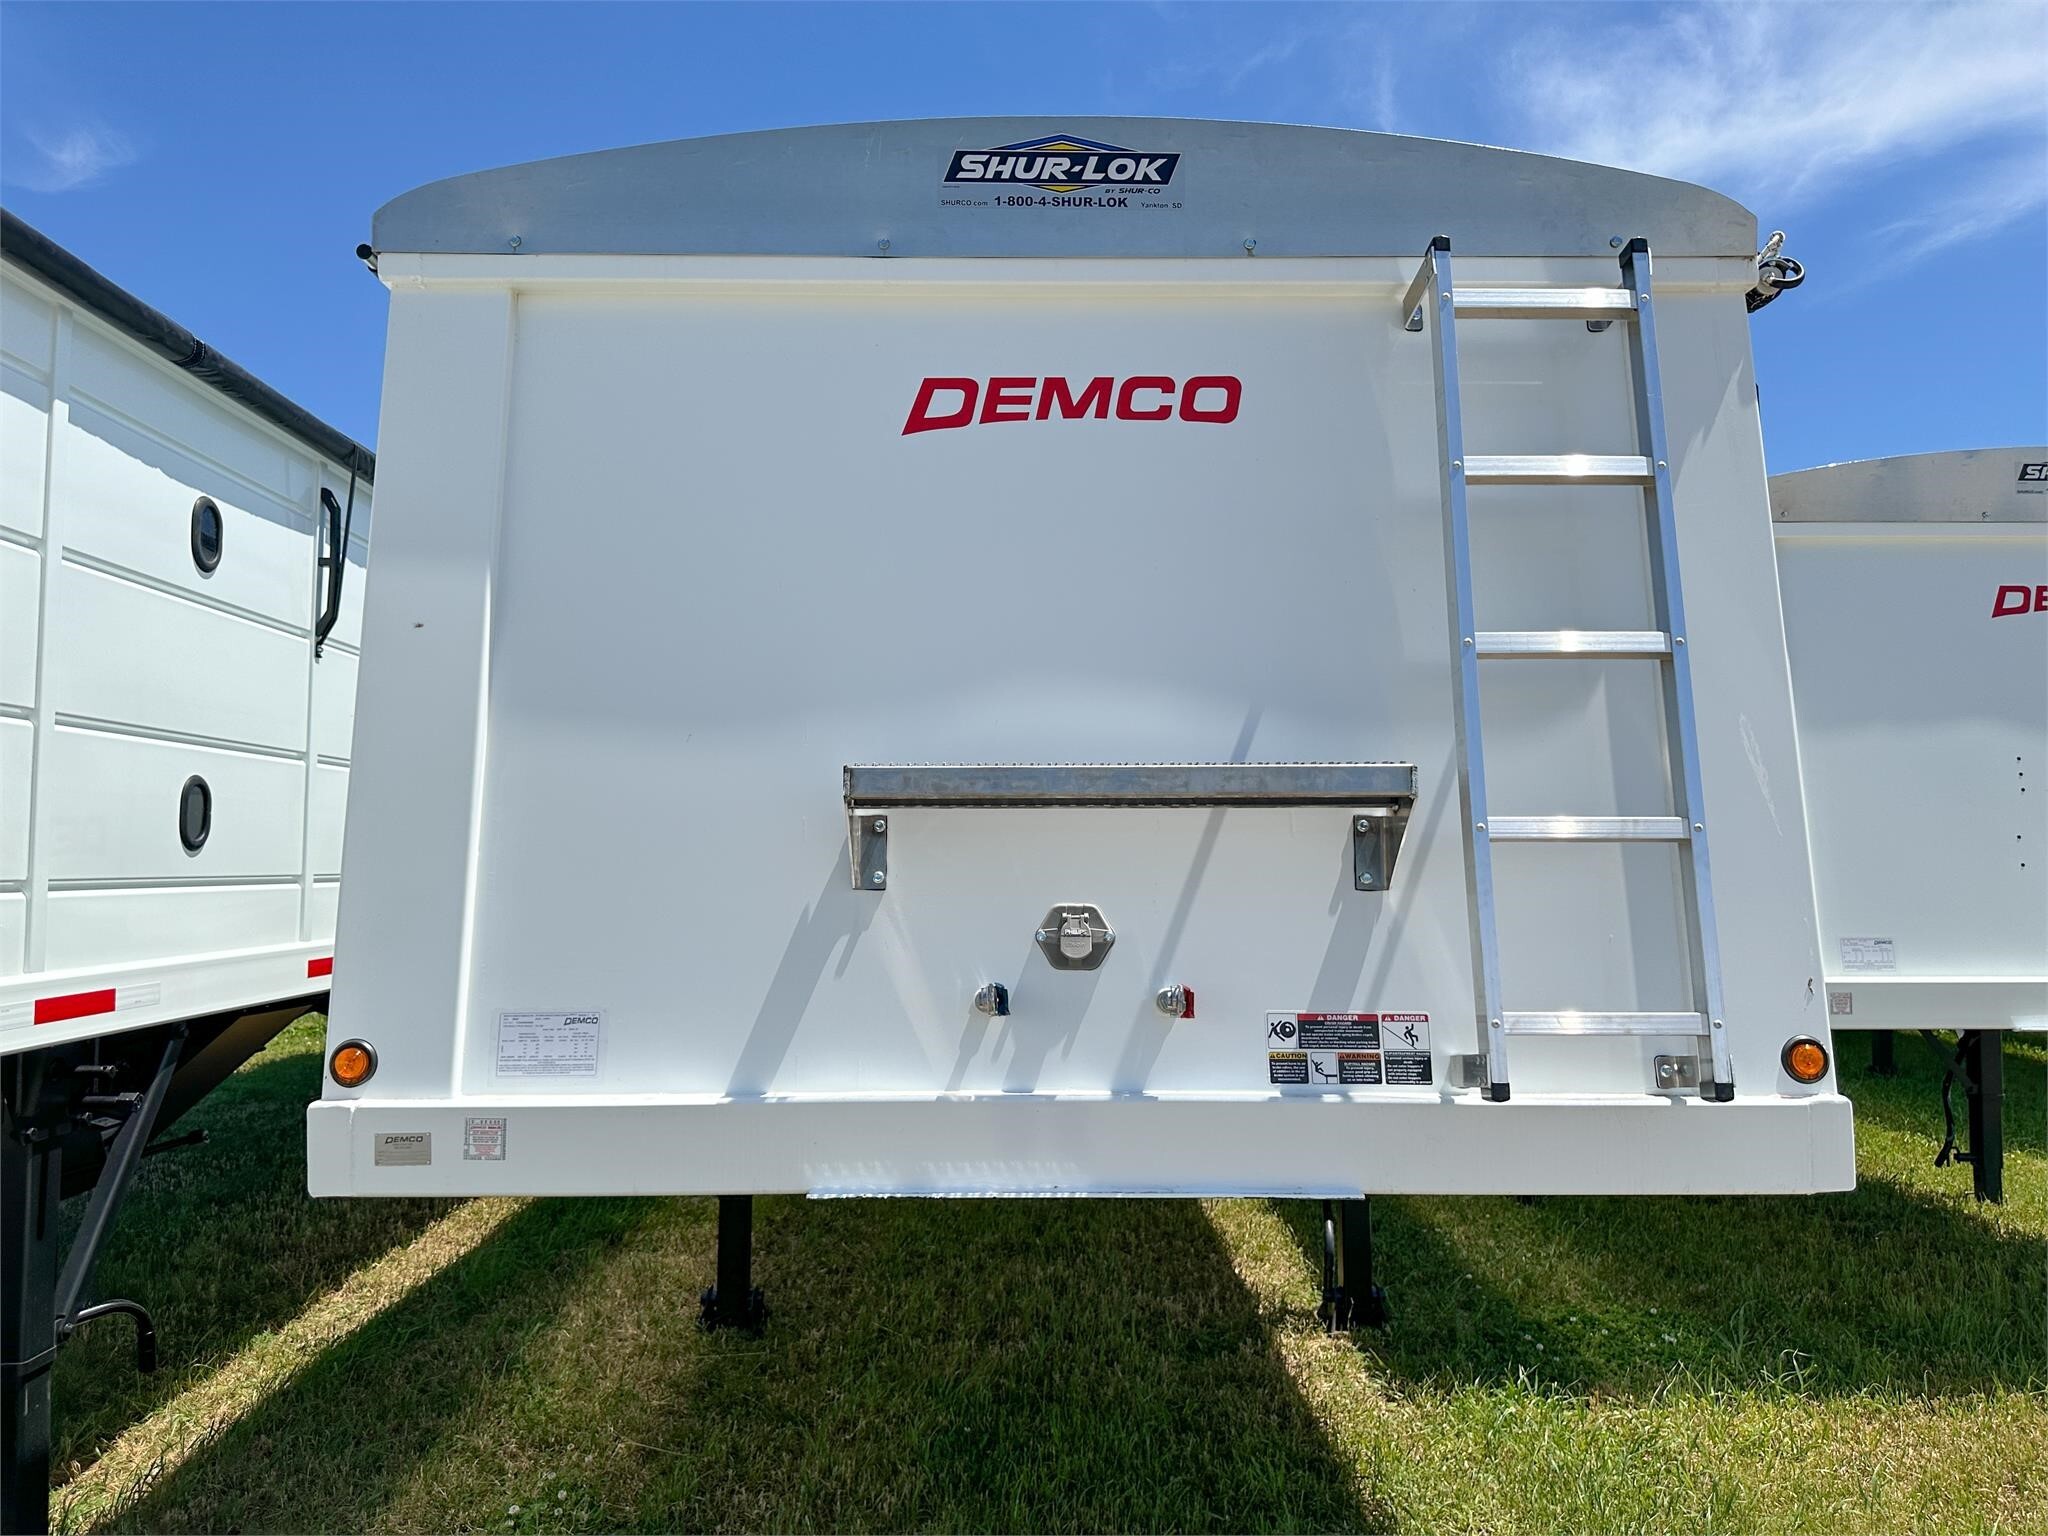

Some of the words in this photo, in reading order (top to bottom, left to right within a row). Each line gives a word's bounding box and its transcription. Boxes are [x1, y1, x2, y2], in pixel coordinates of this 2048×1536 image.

[956, 154, 1168, 181] SHUR-LOK
[994, 196, 1128, 208] 1-800-4-SHUR-LOK
[901, 375, 1243, 436] DEMCO
[564, 1017, 599, 1026] DEMCO
[385, 1136, 424, 1144] DEMCO
